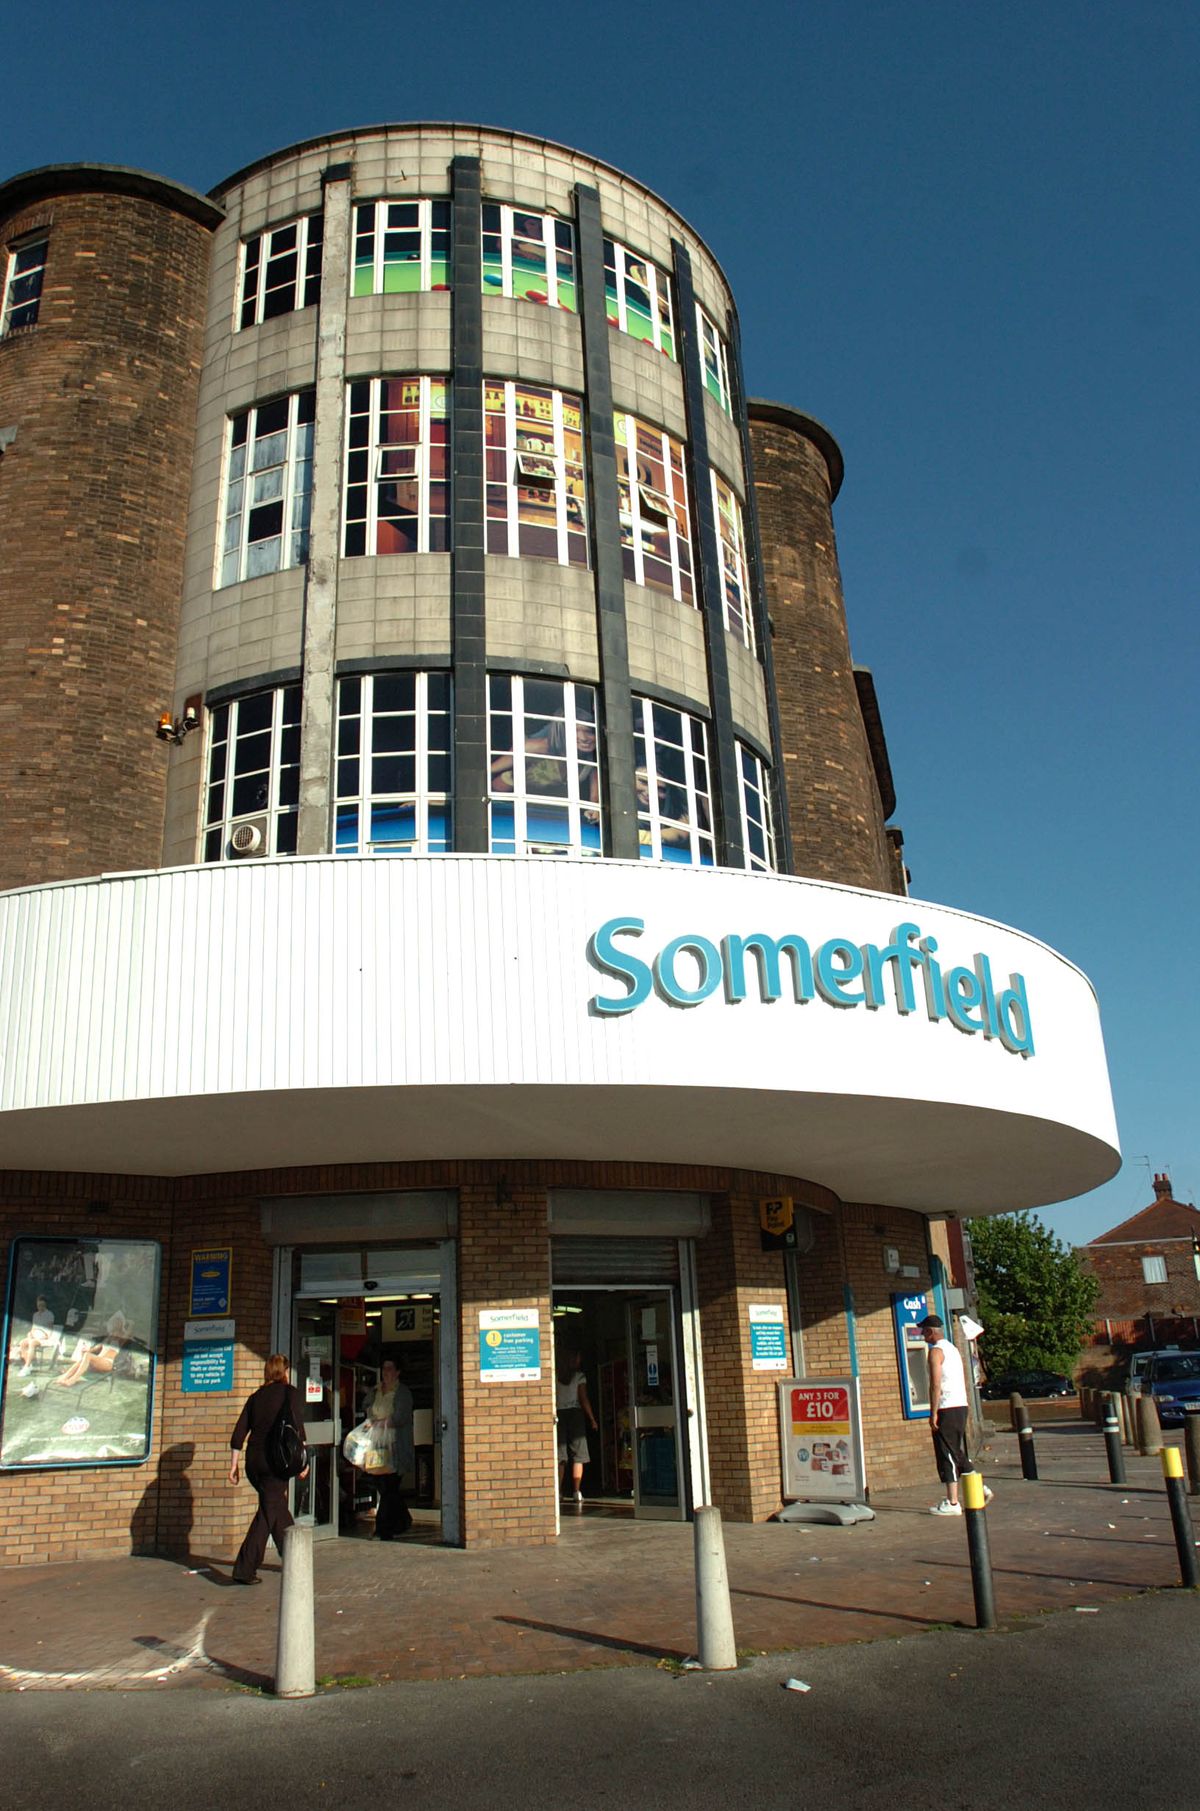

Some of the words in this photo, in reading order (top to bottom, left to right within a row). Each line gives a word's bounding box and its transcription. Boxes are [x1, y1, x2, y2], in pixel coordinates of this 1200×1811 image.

[586, 916, 1035, 1059] Somerfield
[193, 1252, 229, 1262] WARNING
[903, 1296, 921, 1310] Cash
[490, 1313, 529, 1322] Somerfield
[799, 1393, 814, 1401] ANY
[816, 1392, 821, 1400] 3
[824, 1392, 840, 1400] FOR
[806, 1401, 834, 1418] £10
